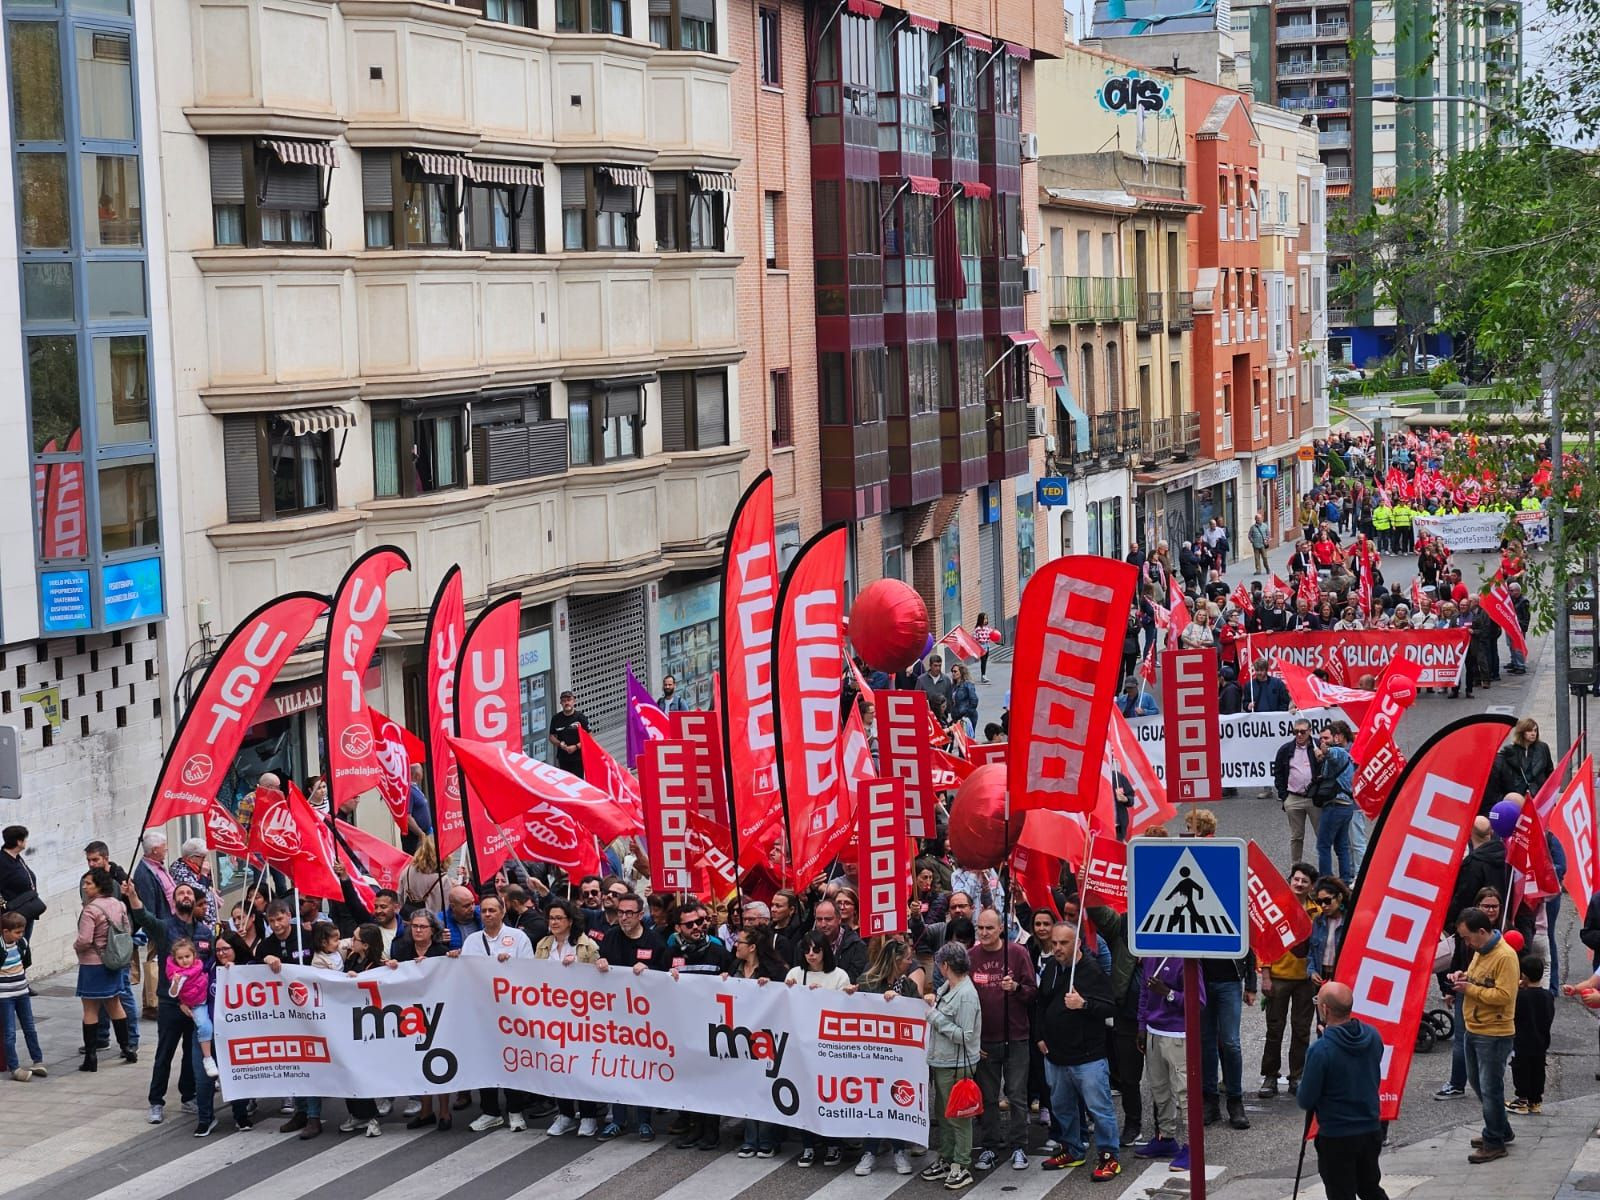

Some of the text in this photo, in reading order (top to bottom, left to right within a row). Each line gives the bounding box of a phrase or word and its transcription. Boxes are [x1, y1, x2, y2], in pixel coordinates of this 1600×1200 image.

[340, 578, 382, 712] UGT
[1404, 639, 1464, 668] DIGNAS
[206, 621, 288, 745] UGT
[794, 589, 841, 796] CCOO
[1026, 572, 1114, 796] CCOO
[274, 686, 323, 715] VILLAL
[1177, 655, 1207, 779] CCOO
[1238, 721, 1276, 738] IGUAL
[164, 790, 208, 806] Guadalajara
[657, 745, 687, 868] CCOO
[868, 783, 897, 912] CCOO
[1351, 772, 1474, 1024] CCOO
[224, 981, 283, 1010] UGT
[493, 977, 650, 1018] Proteger lo
[225, 1009, 327, 1024] Castilla-La Mancha
[823, 1016, 895, 1038] CCOO
[234, 1040, 303, 1061] CCOO
[498, 1015, 676, 1057] conquistado,
[818, 1042, 894, 1053] comisiones obreras
[231, 1064, 300, 1073] comisiones obreras
[503, 1045, 675, 1083] ganar futuro
[818, 1050, 904, 1063] de Castilla-La Mancha
[232, 1070, 310, 1081] de Castilla-La Mancha
[817, 1075, 885, 1105] UGT
[818, 1105, 927, 1128] Castilla-La Mancha
